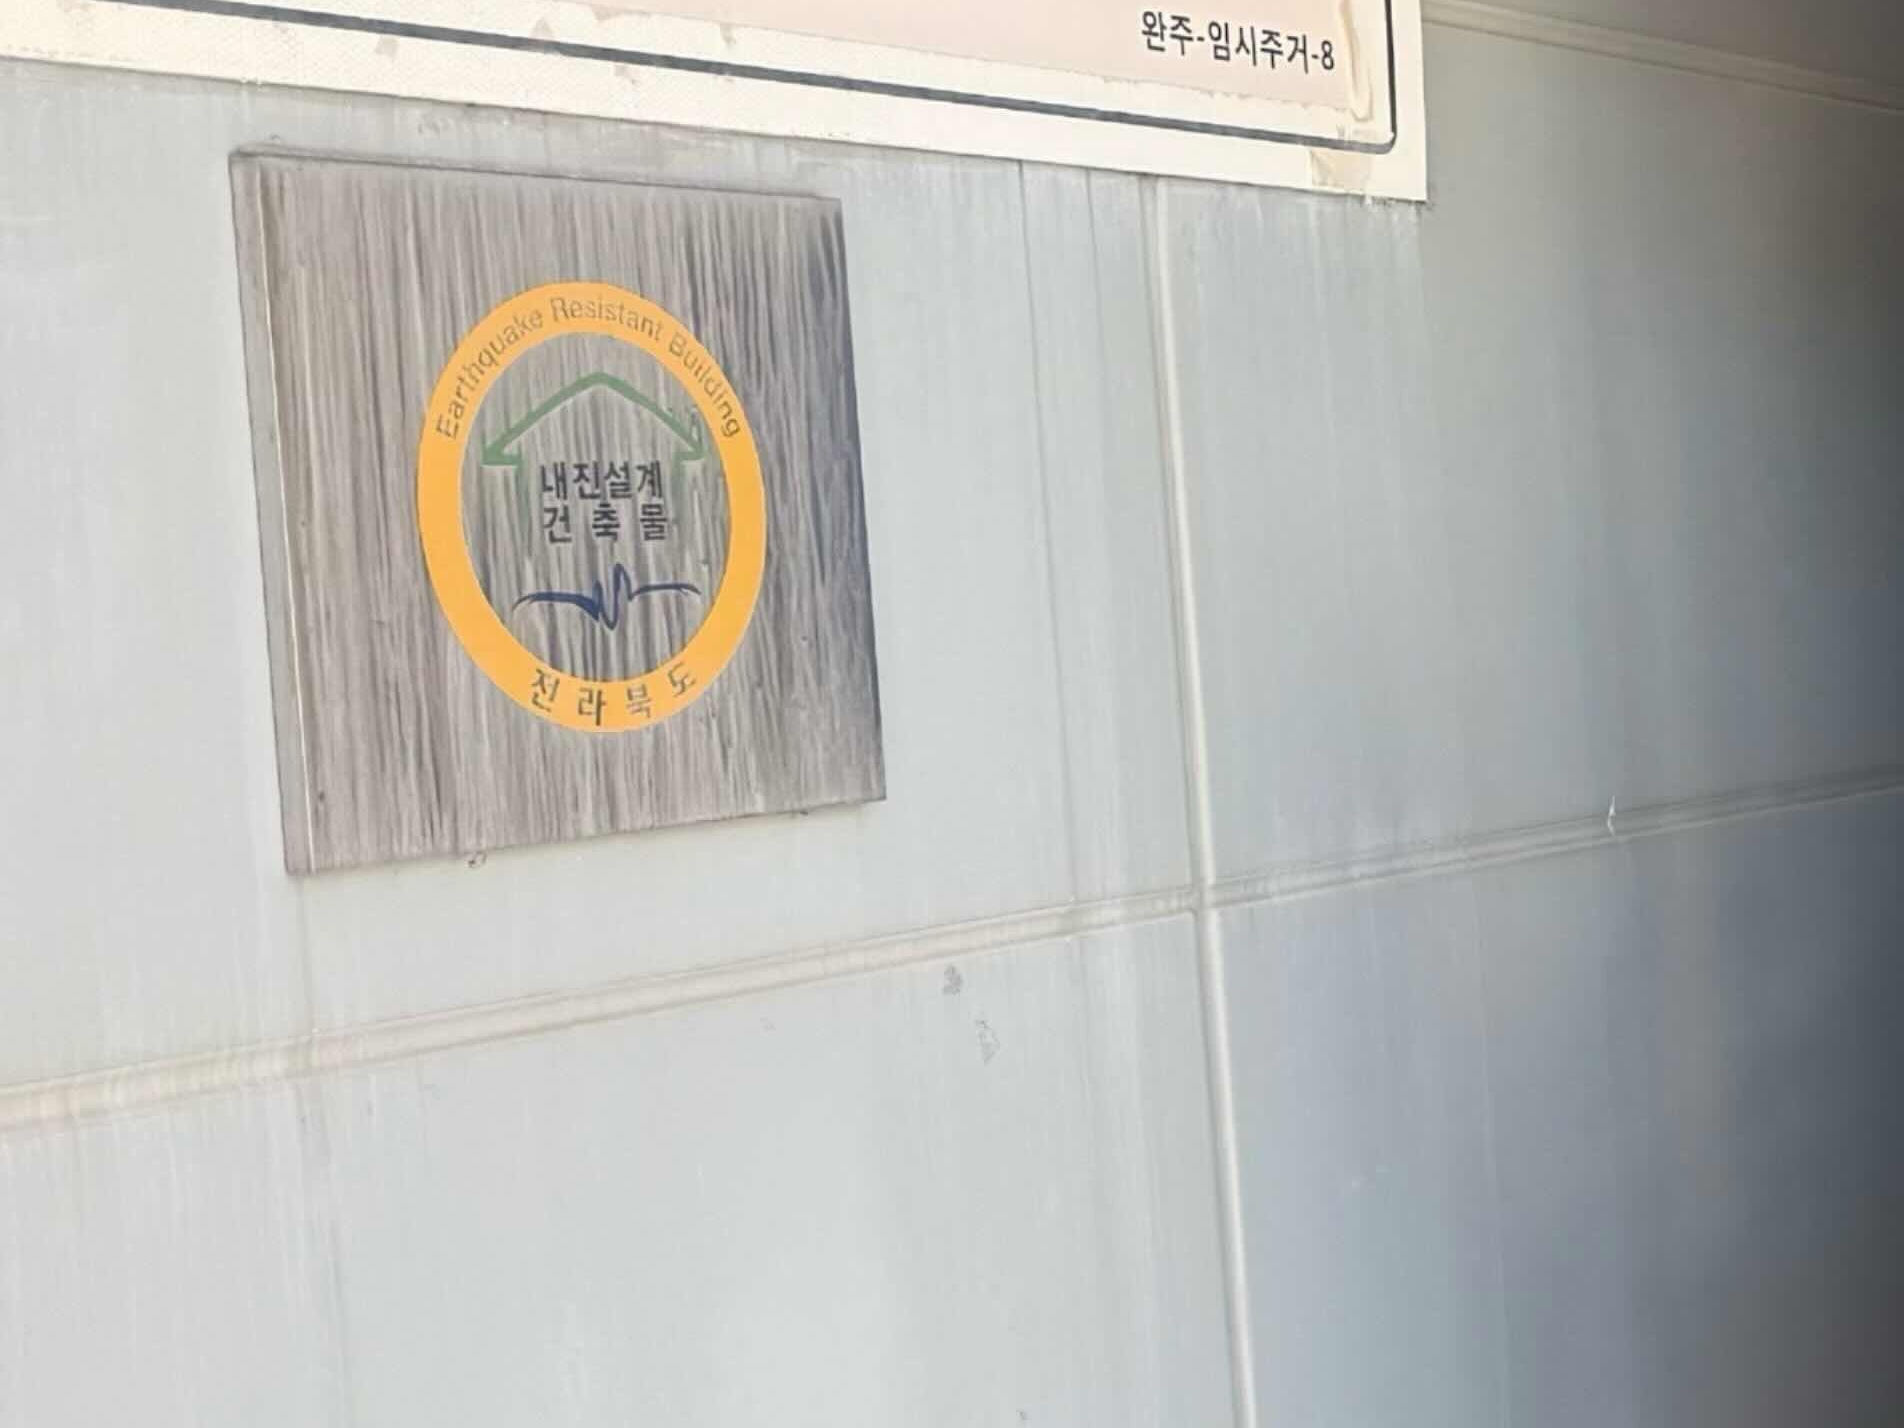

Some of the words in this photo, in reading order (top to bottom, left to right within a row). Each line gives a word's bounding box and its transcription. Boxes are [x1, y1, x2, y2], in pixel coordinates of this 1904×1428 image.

[1141, 10, 1335, 73] 완주-임시주거-8
[436, 309, 544, 439] Earthquake
[550, 296, 663, 342] Resistant
[668, 332, 741, 438] Building
[541, 460, 662, 501] 내진설계
[544, 502, 668, 544] 건축물
[530, 663, 696, 726] 전라북도
